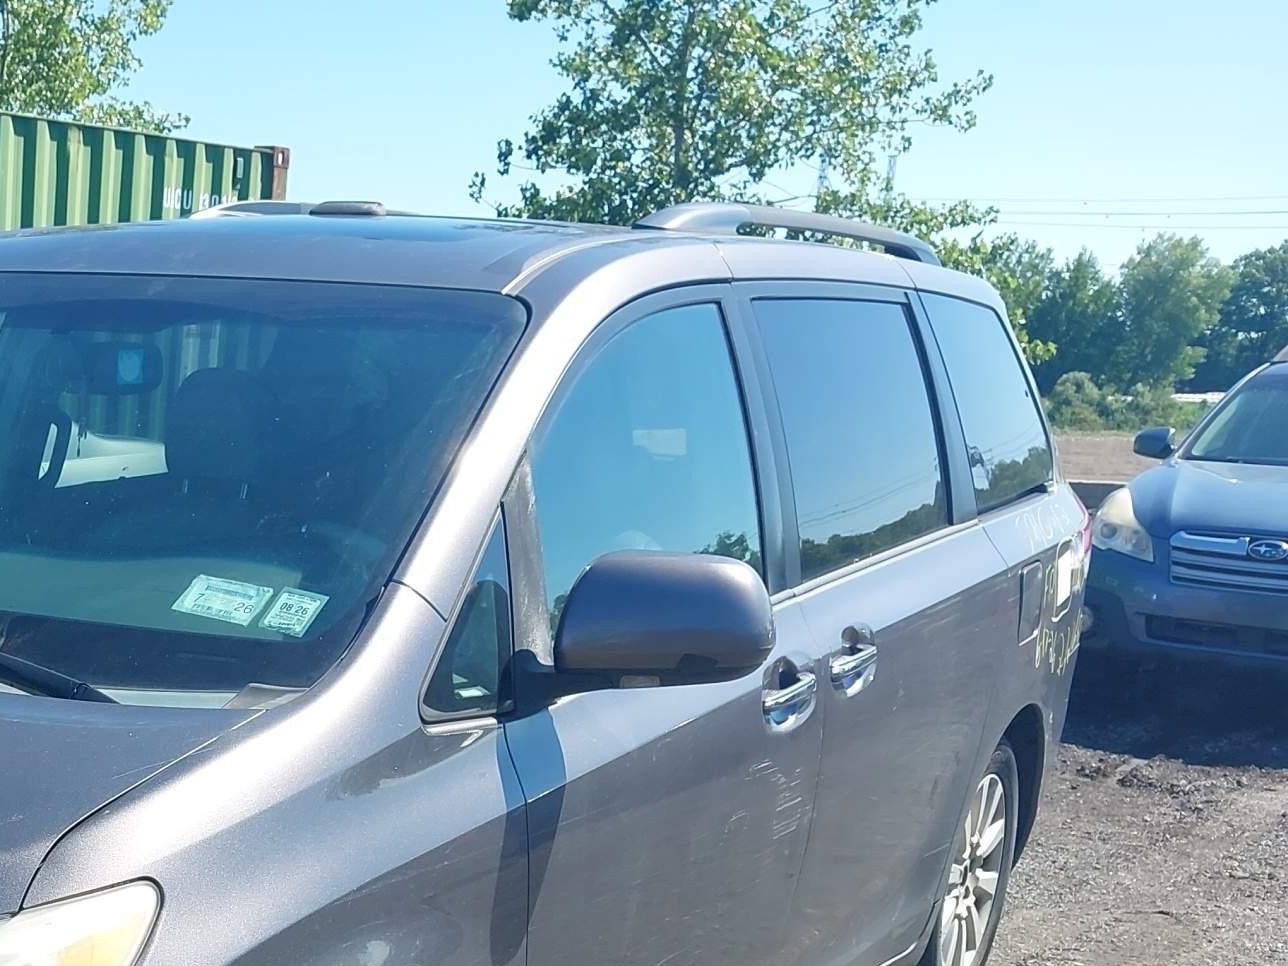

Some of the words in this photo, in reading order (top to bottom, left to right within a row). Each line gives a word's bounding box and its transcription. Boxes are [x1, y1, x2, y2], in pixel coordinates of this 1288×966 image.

[233, 601, 255, 614] 26
[279, 602, 294, 612] 08
[294, 605, 310, 616] 26
